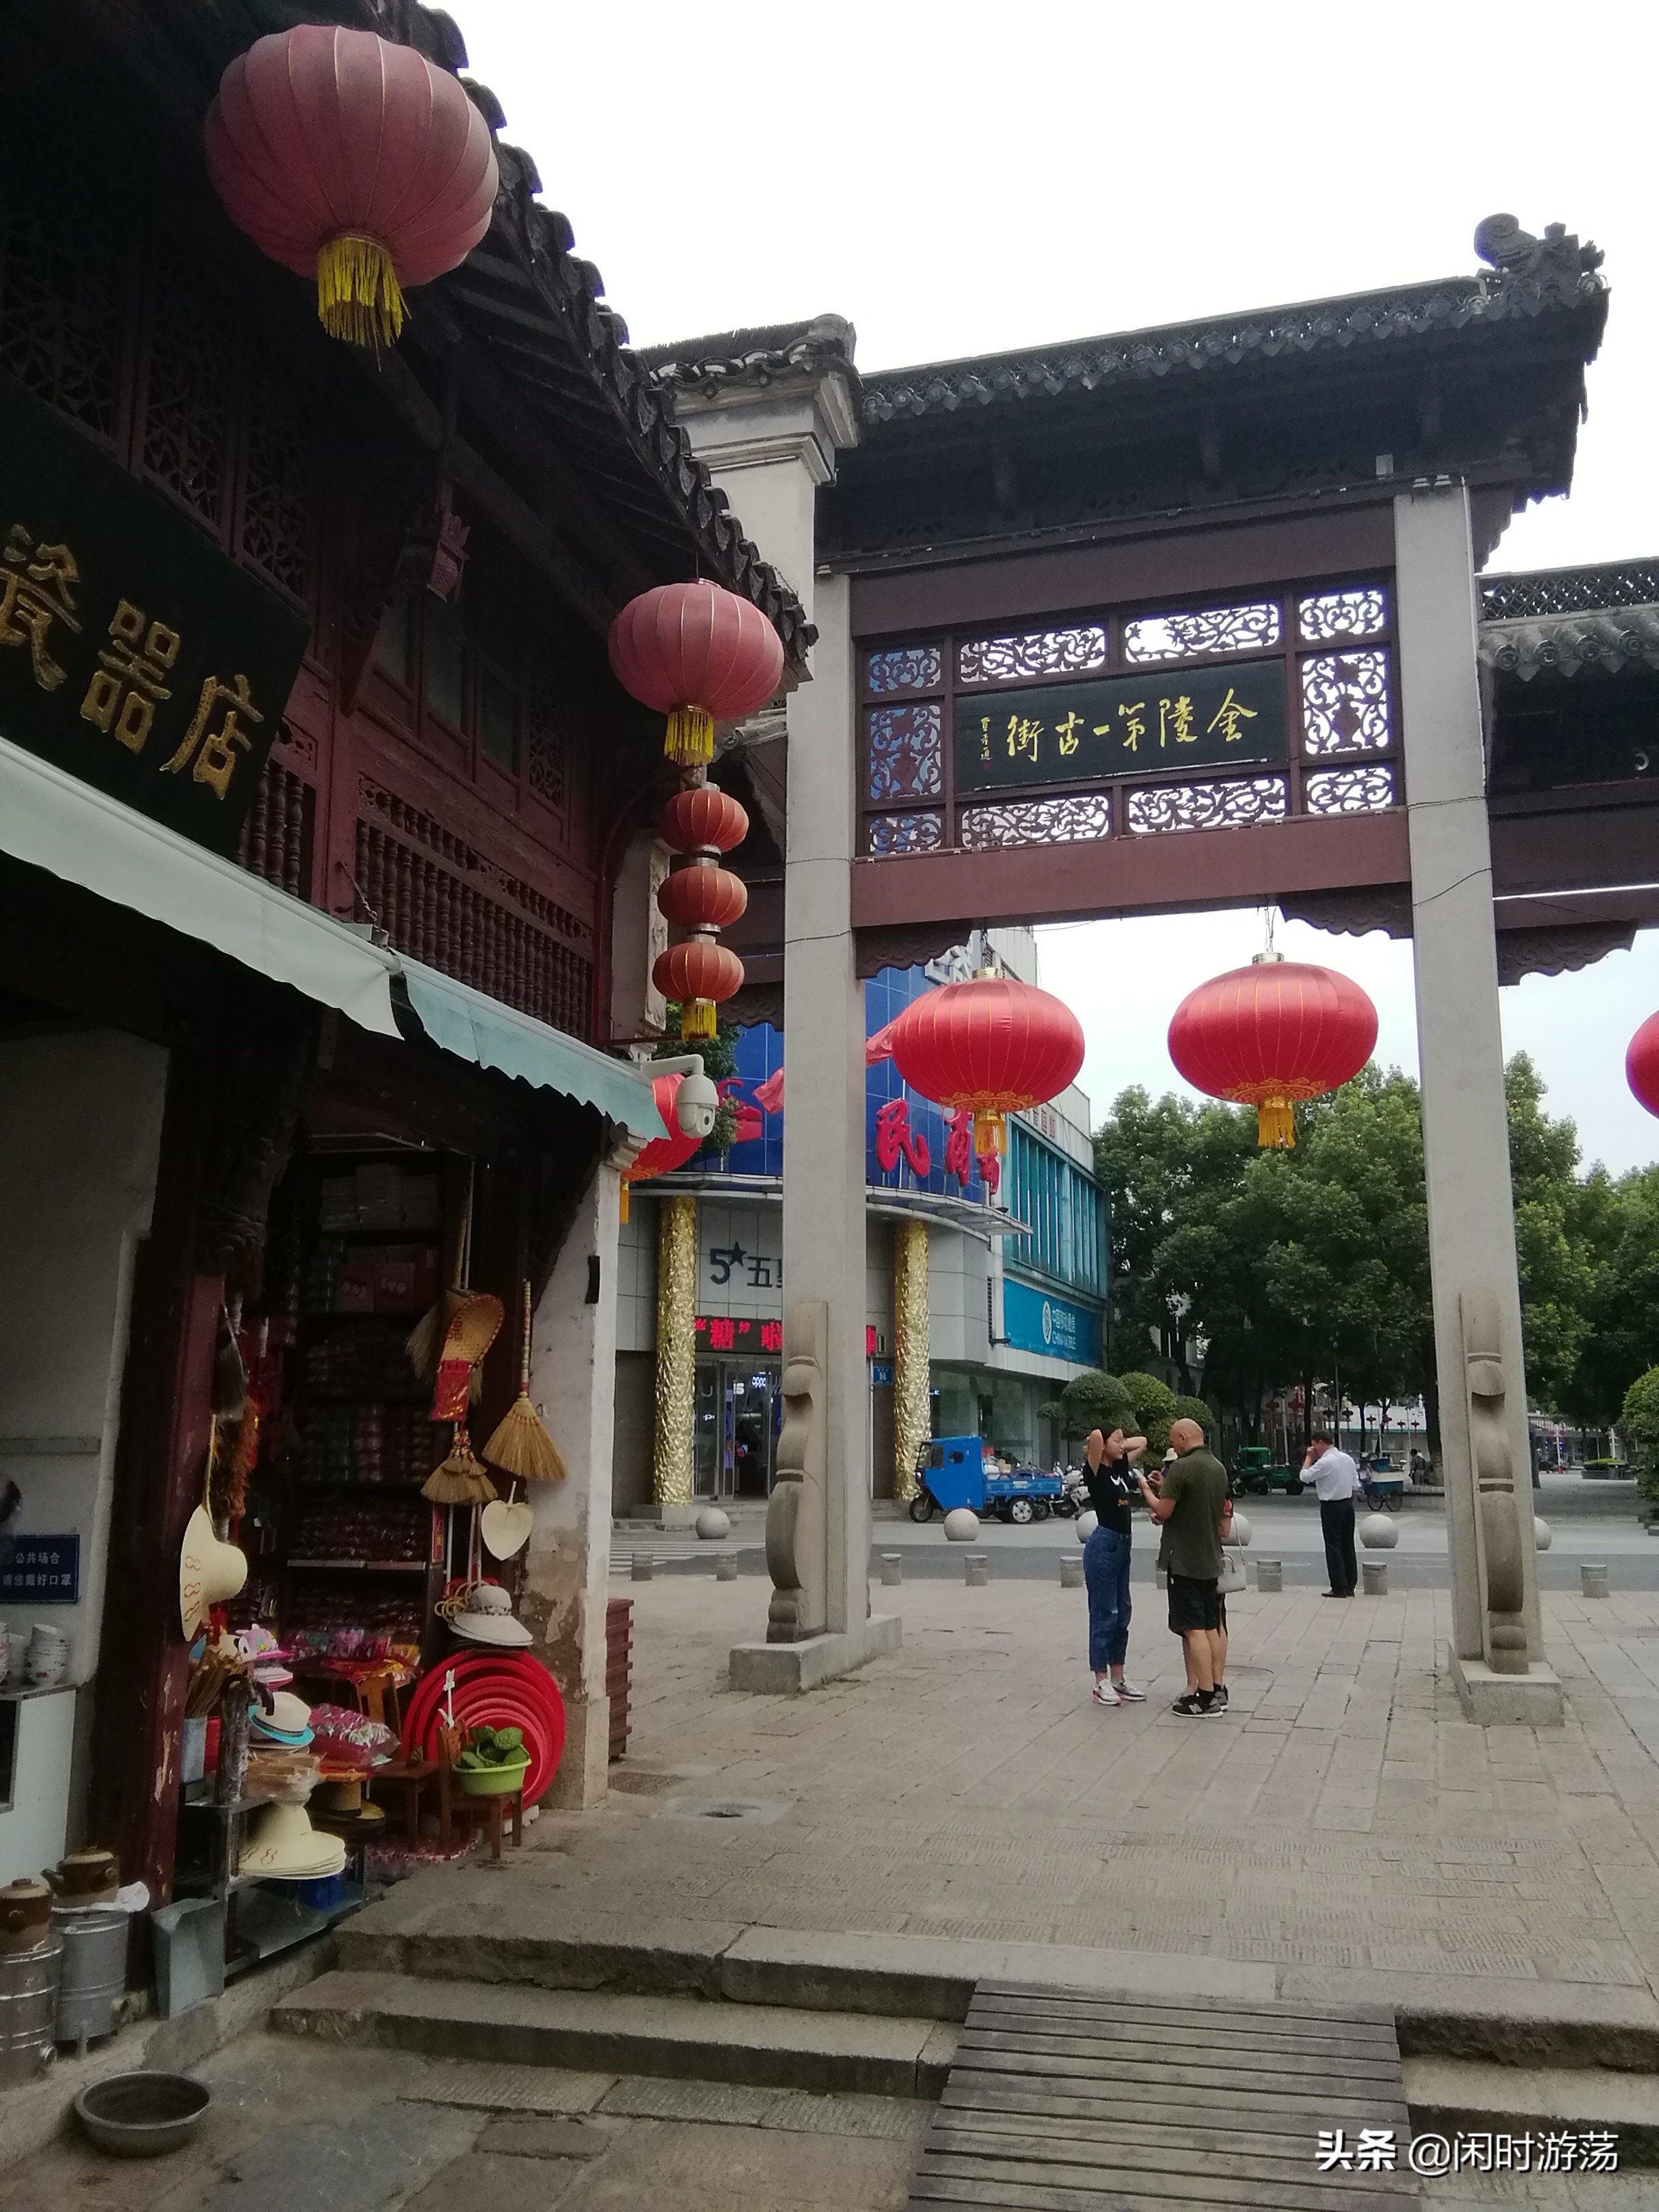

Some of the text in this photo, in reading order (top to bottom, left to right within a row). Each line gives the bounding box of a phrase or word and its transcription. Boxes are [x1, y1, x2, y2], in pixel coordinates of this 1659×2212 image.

[0, 524, 264, 800] 瓷器店
[1006, 688, 1258, 762] 金陵第一古街
[747, 1256, 783, 1288] 五
[16, 1552, 60, 1564] 公共场合
